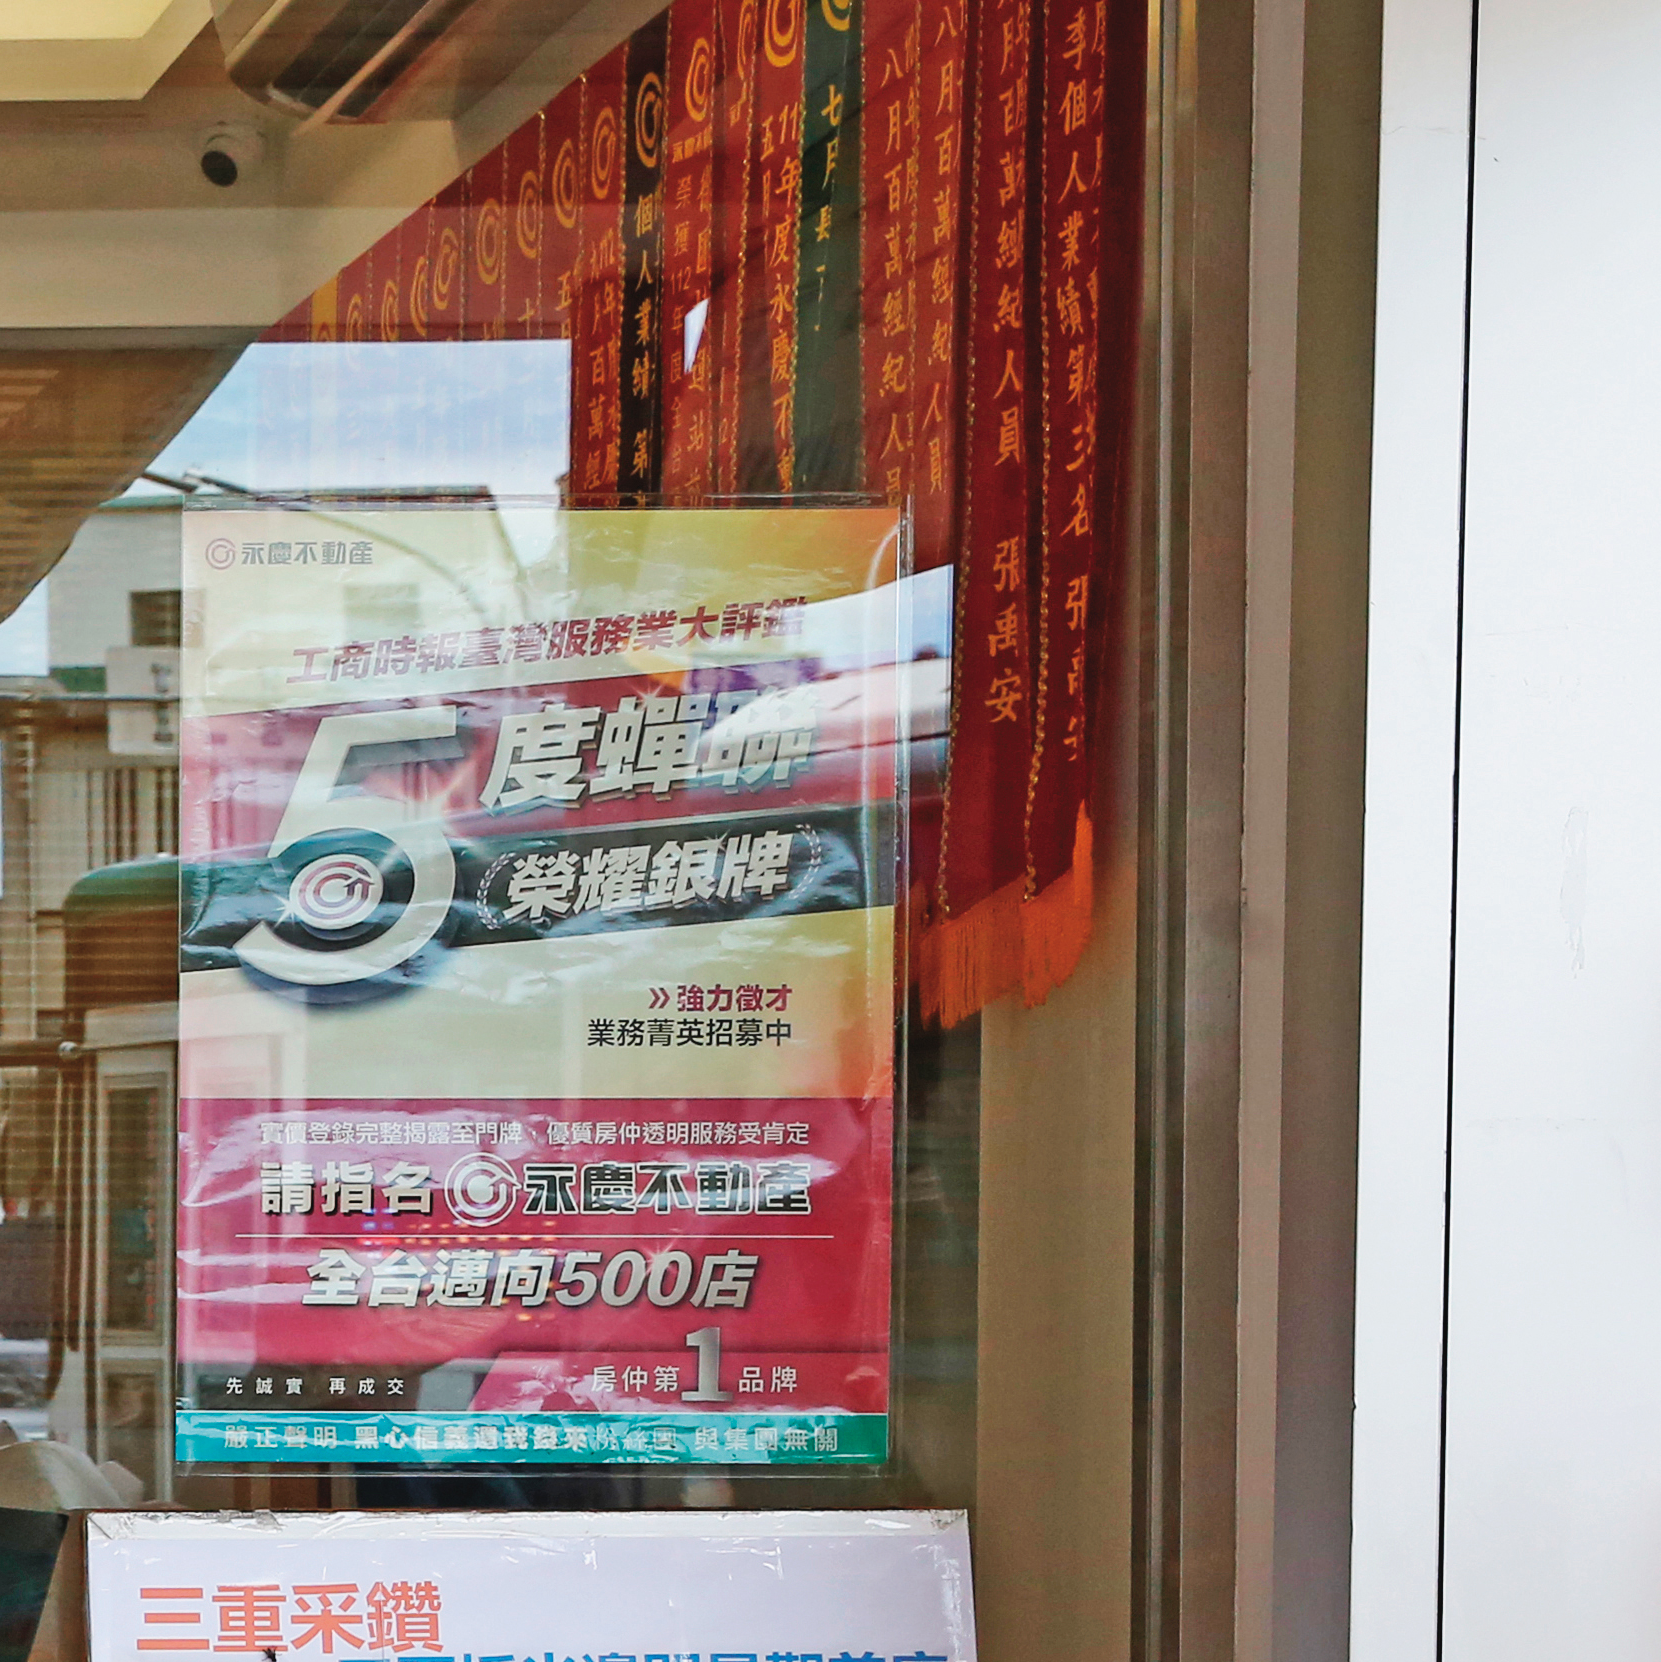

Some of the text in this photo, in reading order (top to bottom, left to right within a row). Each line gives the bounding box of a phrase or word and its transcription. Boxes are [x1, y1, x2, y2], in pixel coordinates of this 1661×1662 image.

[241, 539, 374, 566] 永慶不動產
[286, 597, 806, 682] 工商時報臺灣服務業大評鑑
[479, 689, 818, 811] 度蟬聯
[503, 830, 794, 923] 榮耀銀牌
[677, 984, 793, 1012] 強力徵才
[588, 1018, 793, 1047] 業務菁英招募中
[260, 1122, 810, 1145] 實價登錄完整揭露至門牌 優質房仲透明服務受肯定
[260, 1161, 811, 1215] 請指名 永慶不動產
[301, 1247, 760, 1309] 全台邁向500店
[226, 1377, 405, 1396] 先誠實 再成交
[591, 1326, 798, 1402] 房仲第1品牌
[224, 1425, 337, 1450] 嚴正聲明
[136, 1581, 443, 1655] 三重采鑽
